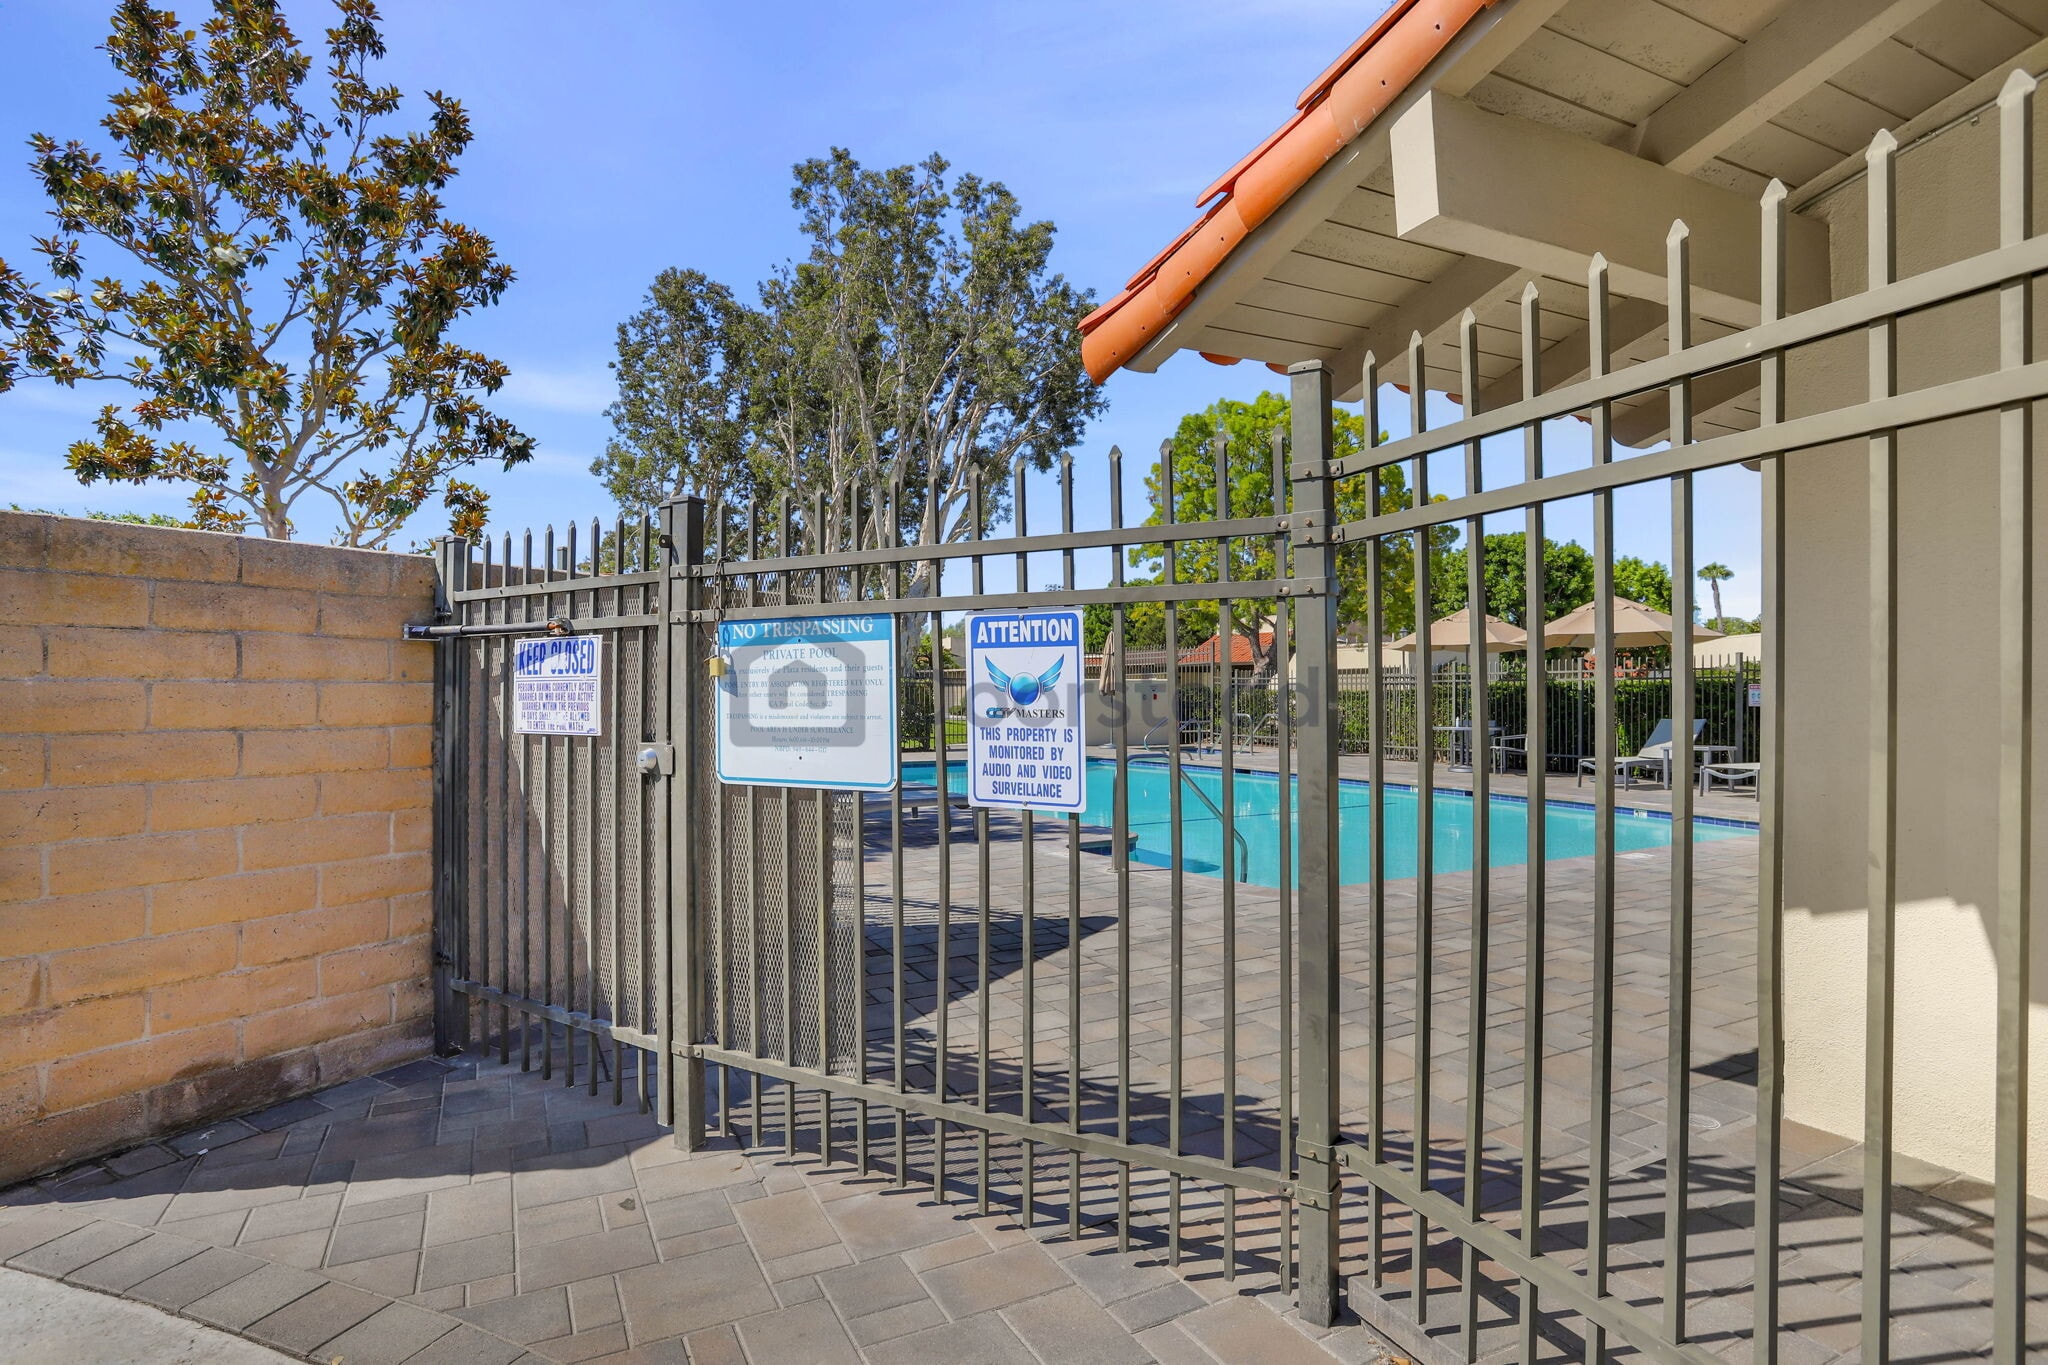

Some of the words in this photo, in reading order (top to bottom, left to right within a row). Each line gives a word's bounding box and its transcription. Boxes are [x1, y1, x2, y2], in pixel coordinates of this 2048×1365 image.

[733, 623, 756, 639] NO
[762, 616, 874, 638] TRESPASSING
[977, 618, 1073, 643] ATTENTION
[519, 642, 546, 675] KEEP
[551, 640, 595, 674] CLOSED
[763, 648, 806, 660] PRIVATE
[809, 647, 838, 659] POOL
[801, 664, 828, 673] residents
[831, 664, 843, 672] and
[845, 663, 860, 672] their
[863, 664, 884, 674] guests
[518, 682, 535, 692] PERSONS
[552, 682, 577, 692] CURRENTLY
[578, 682, 595, 692] ACTIVE
[770, 680, 809, 688] ASSOCIATION
[827, 689, 868, 697] TRESPASSING
[558, 702, 567, 711] THE
[567, 702, 590, 712] PREVIOUS
[985, 707, 1017, 718] CCTV
[1017, 708, 1065, 718] MASTERS
[980, 727, 1001, 741] THIS
[1006, 728, 1057, 742] PROPERTY
[1064, 728, 1073, 743] IS
[989, 745, 1044, 760] MONITORED
[1050, 747, 1064, 761] BY
[982, 763, 1011, 777] AUDIO
[1017, 764, 1036, 778] AND
[1042, 765, 1072, 780] VIDEO
[992, 781, 1062, 798] SURVEILLANCE
